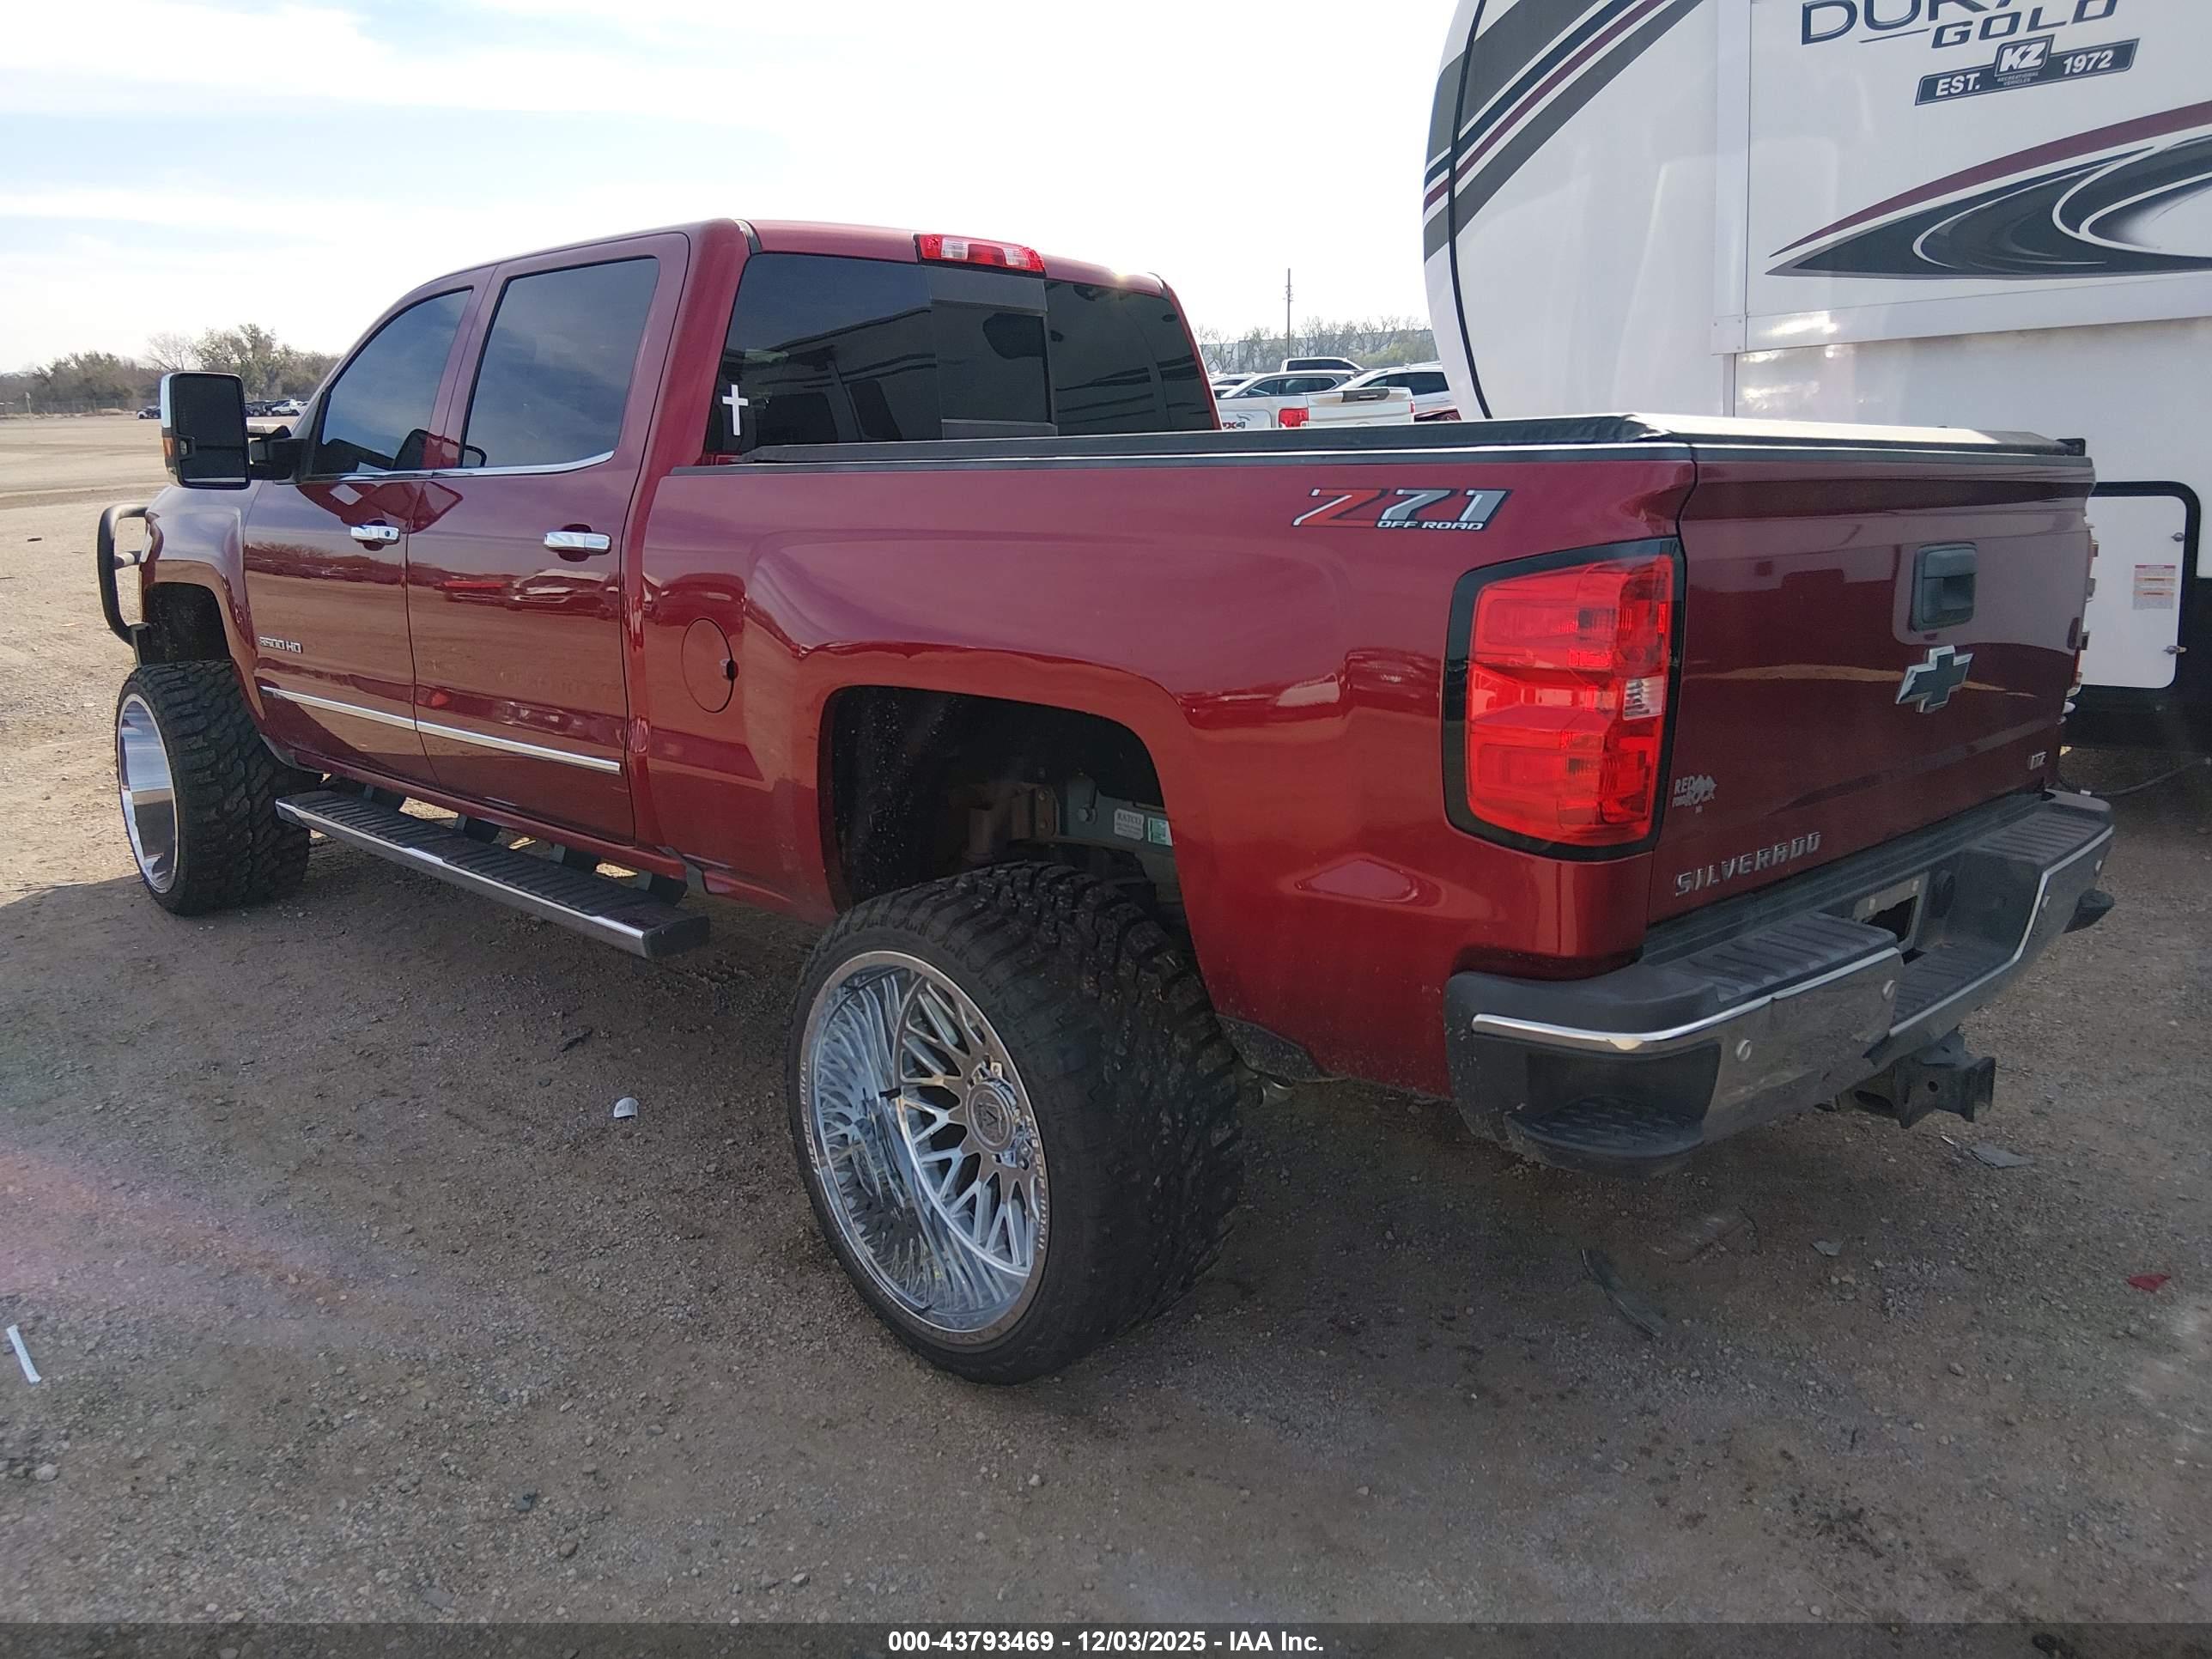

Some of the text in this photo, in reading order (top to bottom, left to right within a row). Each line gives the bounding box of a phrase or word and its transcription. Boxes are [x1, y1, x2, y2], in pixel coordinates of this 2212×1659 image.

[1932, 0, 2117, 48] GOLD
[1936, 51, 2113, 96] EST. 1972
[1999, 41, 2046, 72] KZ
[1292, 489, 1509, 526] Z71
[1422, 521, 1484, 531] ROAD
[1675, 832, 1820, 896] SILVERADO
